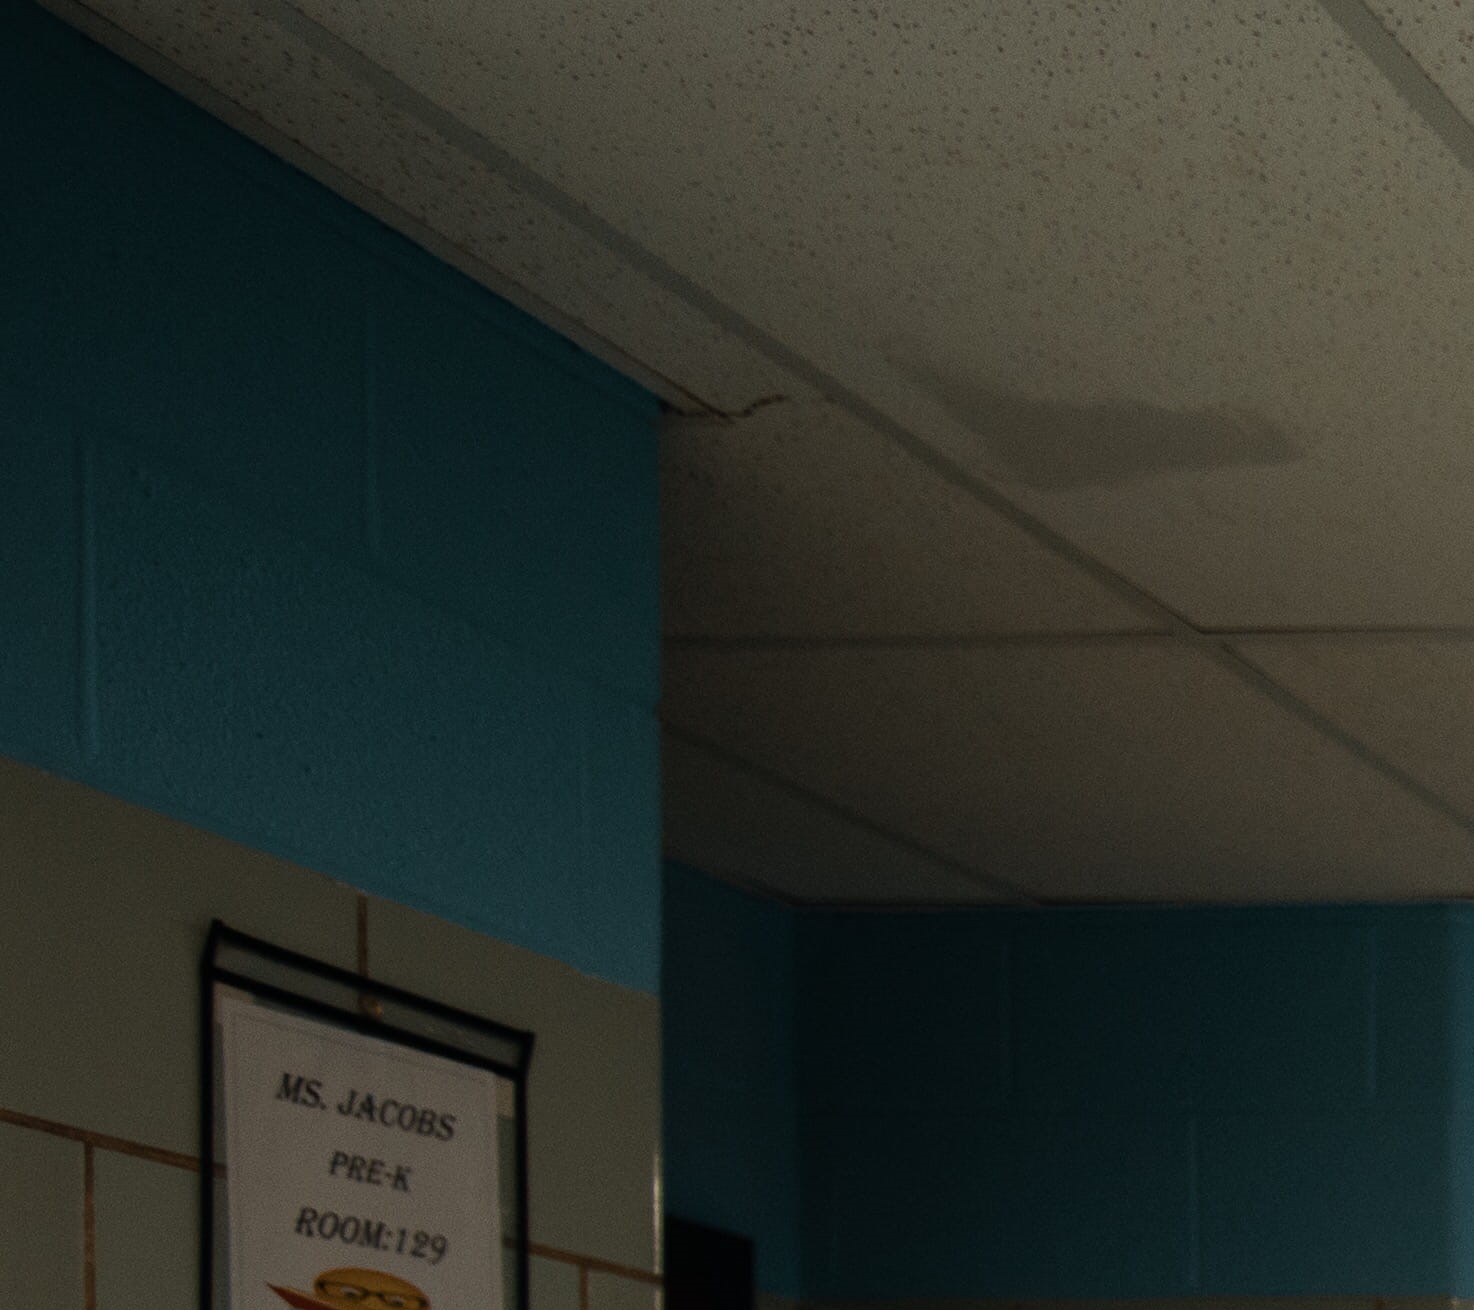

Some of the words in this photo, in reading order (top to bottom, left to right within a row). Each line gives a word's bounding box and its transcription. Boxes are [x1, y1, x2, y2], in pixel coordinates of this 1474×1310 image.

[276, 1072, 327, 1110] MS.
[337, 1089, 457, 1142] JACOBS
[328, 1151, 412, 1192] PRE-K
